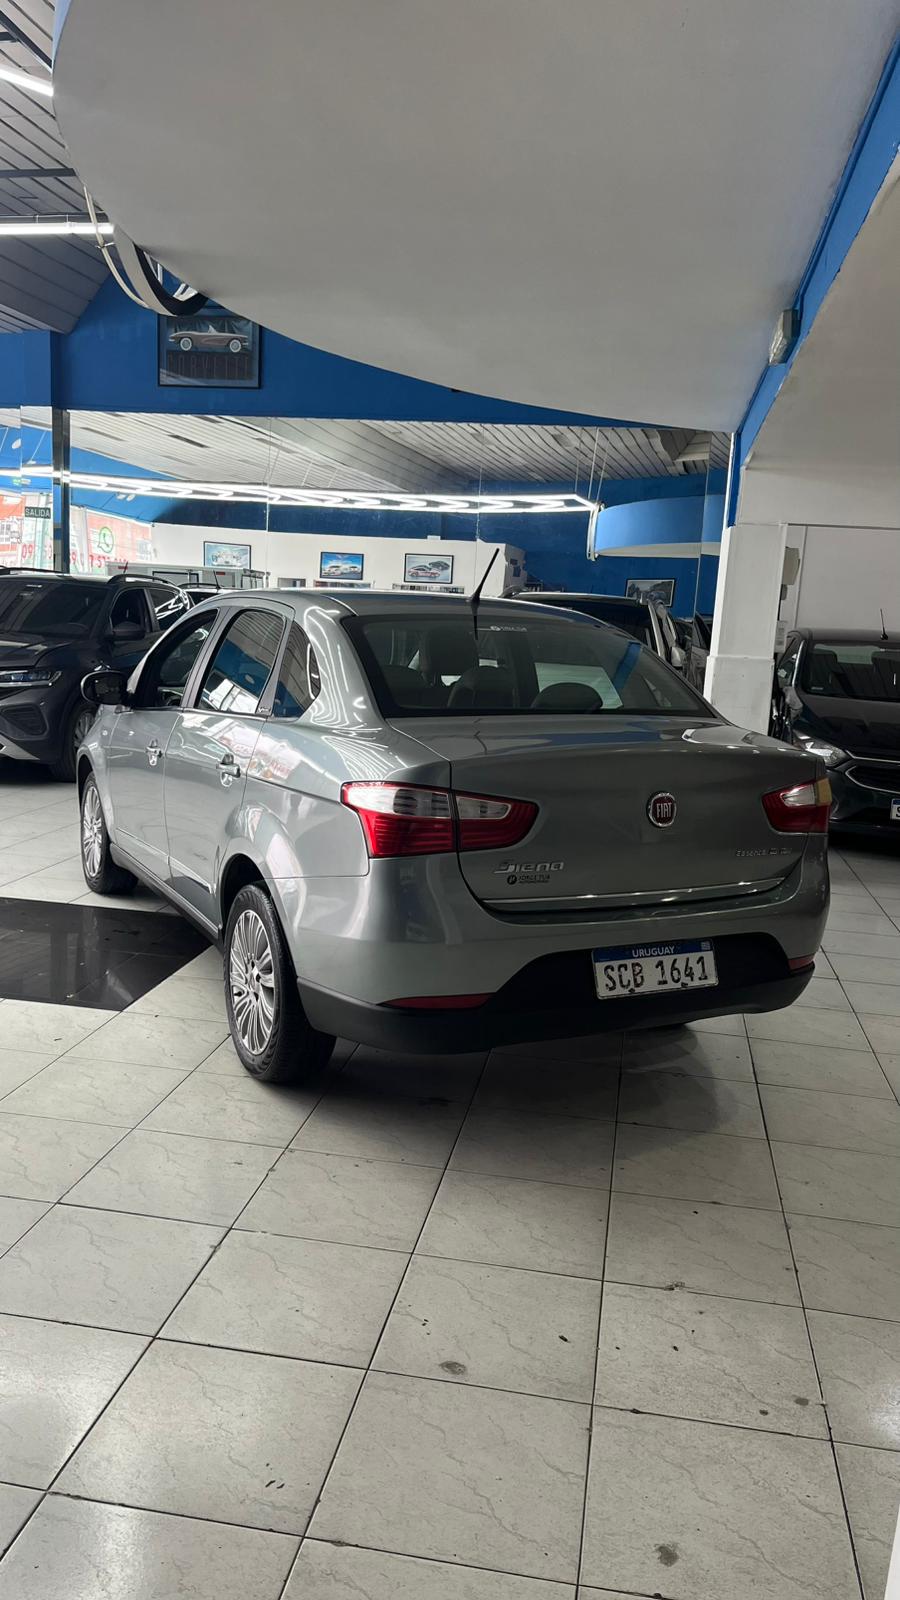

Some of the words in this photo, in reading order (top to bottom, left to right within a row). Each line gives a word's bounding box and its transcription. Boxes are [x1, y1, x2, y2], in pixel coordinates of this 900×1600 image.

[25, 507, 51, 518] SALIDA
[656, 802, 672, 818] FIAT
[493, 859, 564, 874] Siena
[631, 945, 676, 958] URUGUAY
[603, 961, 645, 992] SCB
[655, 956, 708, 986] 1641
